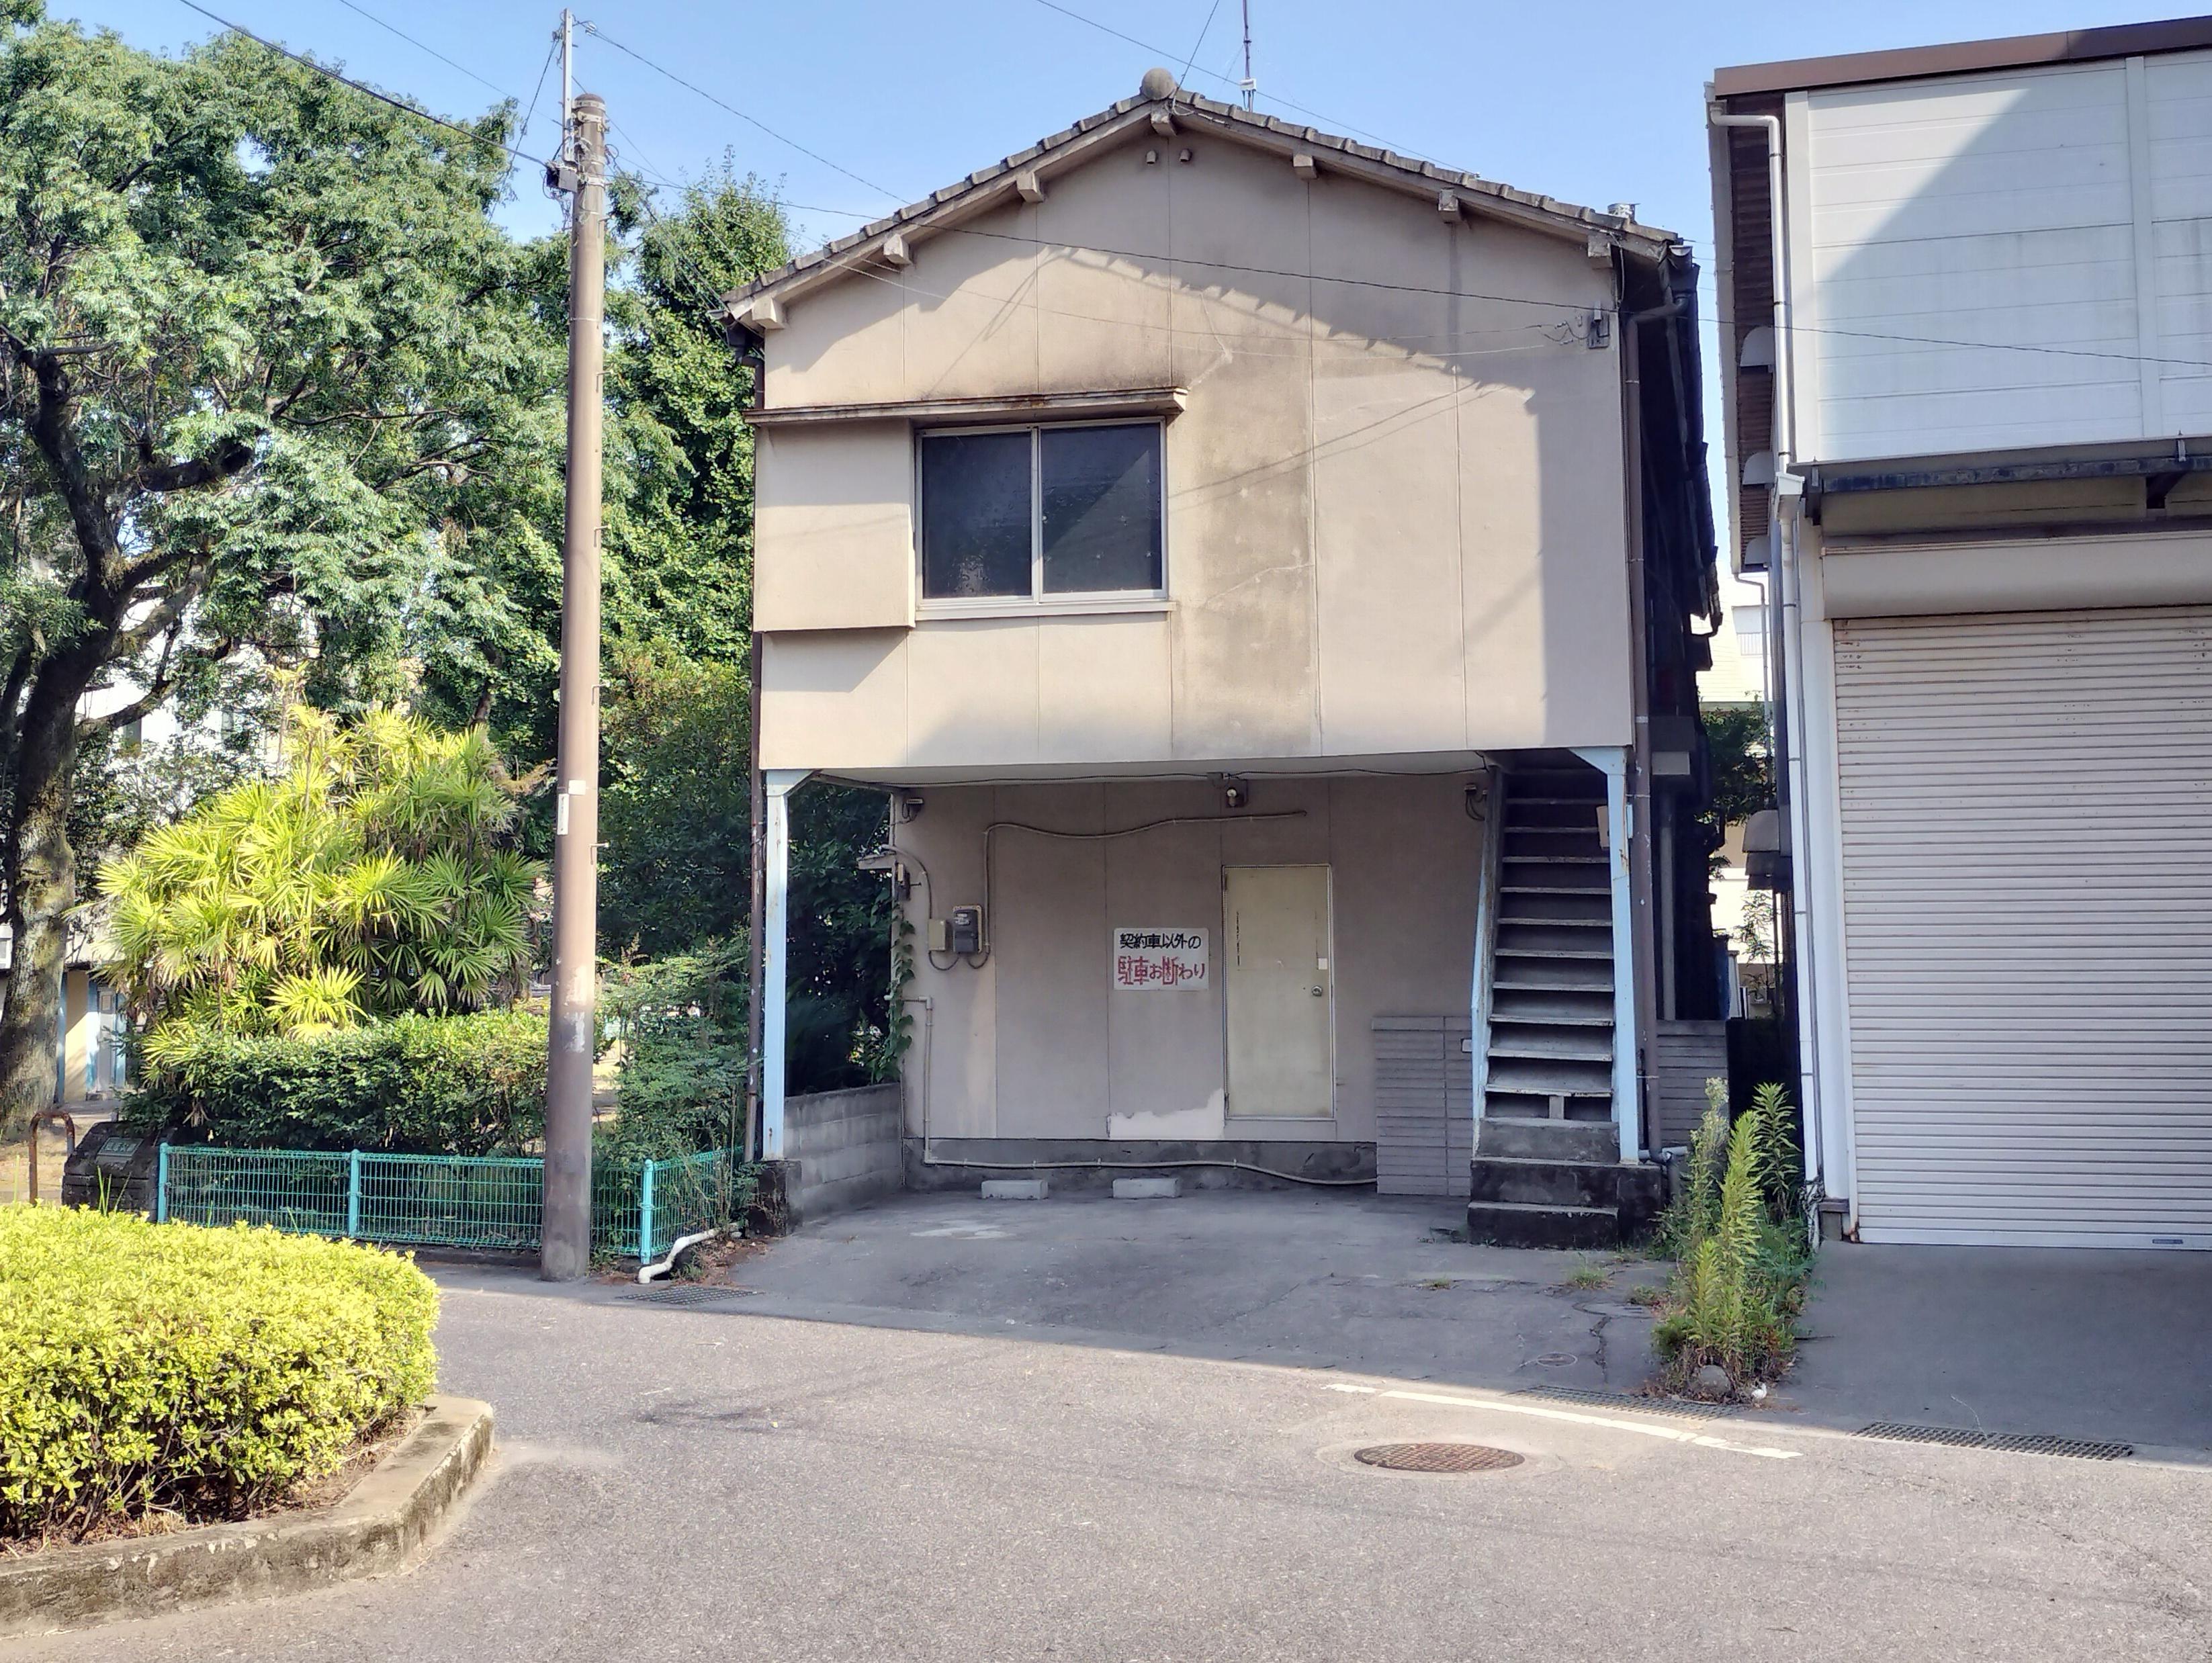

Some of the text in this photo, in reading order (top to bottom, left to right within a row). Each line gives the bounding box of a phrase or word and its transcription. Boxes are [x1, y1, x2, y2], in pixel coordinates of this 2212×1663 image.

[1120, 933, 1202, 949] 契約車以外の
[1118, 955, 1205, 985] 駐車お断わり
